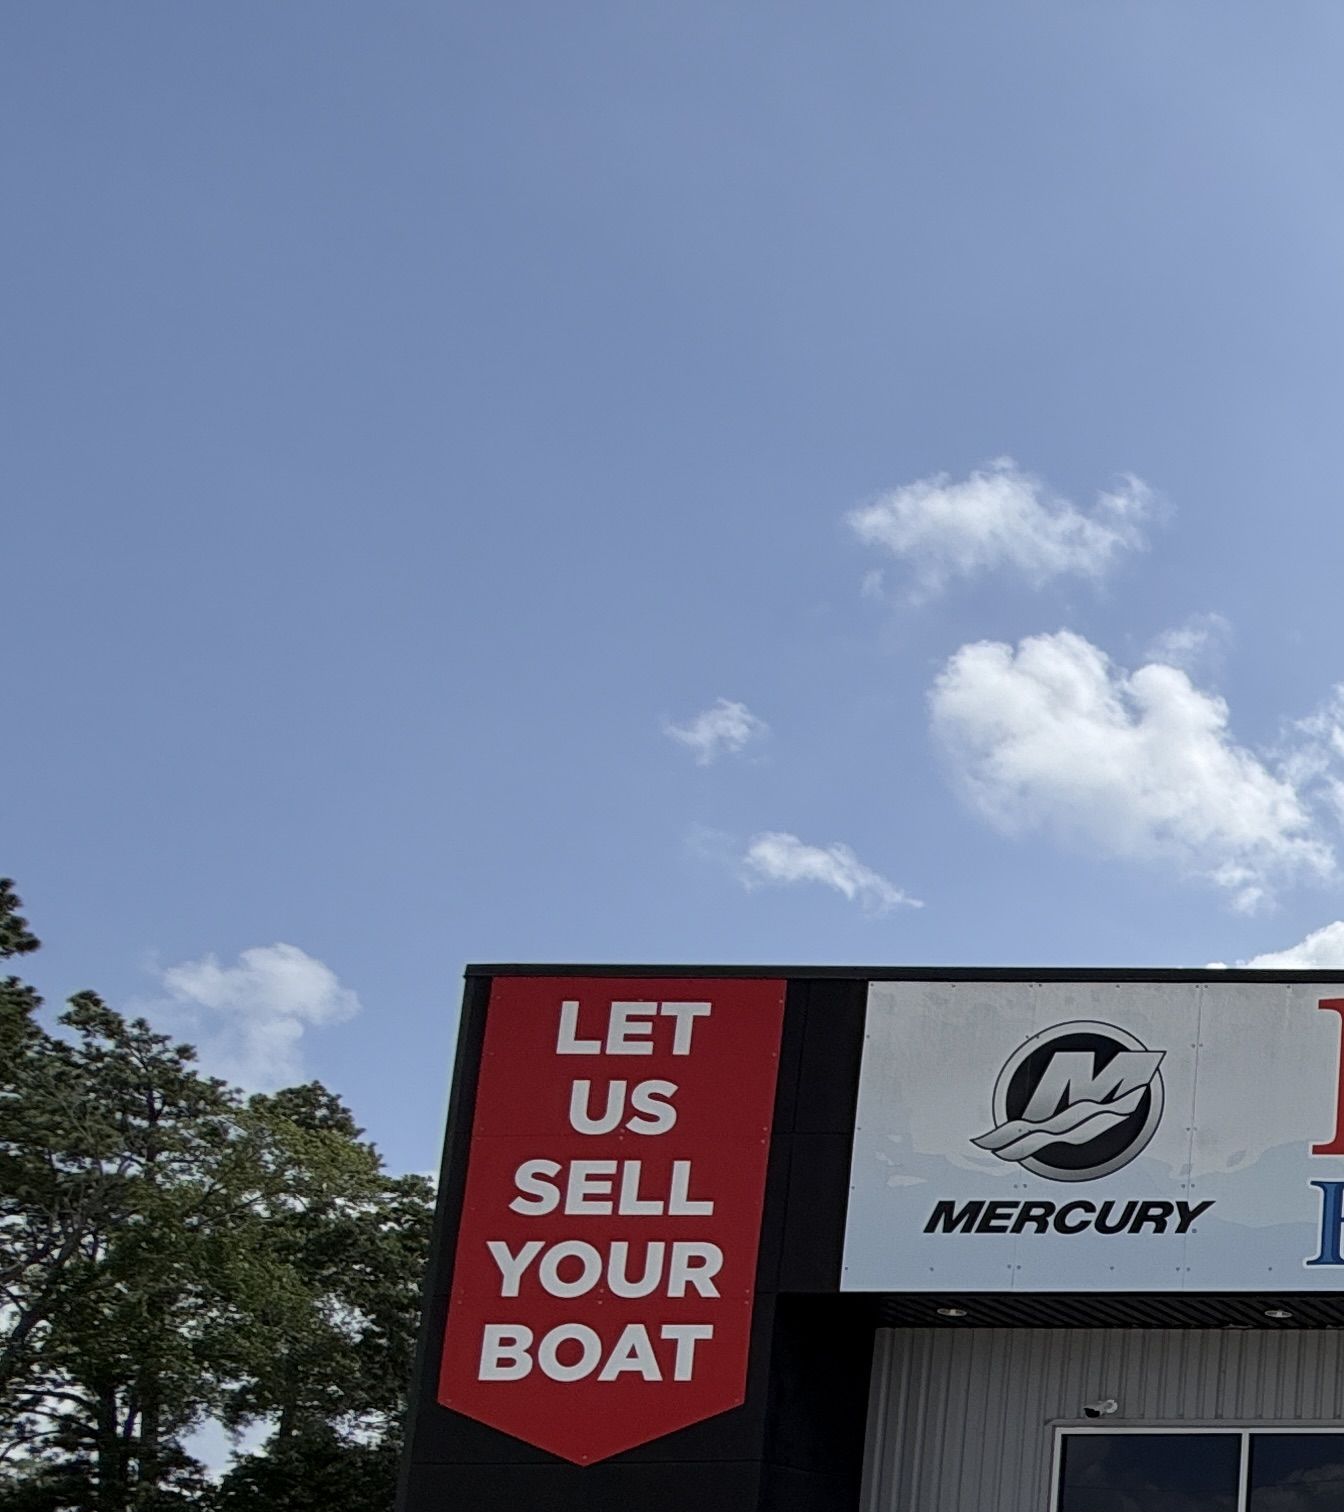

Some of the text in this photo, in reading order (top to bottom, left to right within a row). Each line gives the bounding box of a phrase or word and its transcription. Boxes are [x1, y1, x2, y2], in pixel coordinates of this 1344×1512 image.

[555, 1001, 712, 1056] LET
[569, 1079, 679, 1135] US
[508, 1159, 714, 1216] SELL
[923, 1199, 1216, 1235] MERCURY
[486, 1240, 724, 1299] YOUR
[478, 1323, 714, 1382] BOAT
